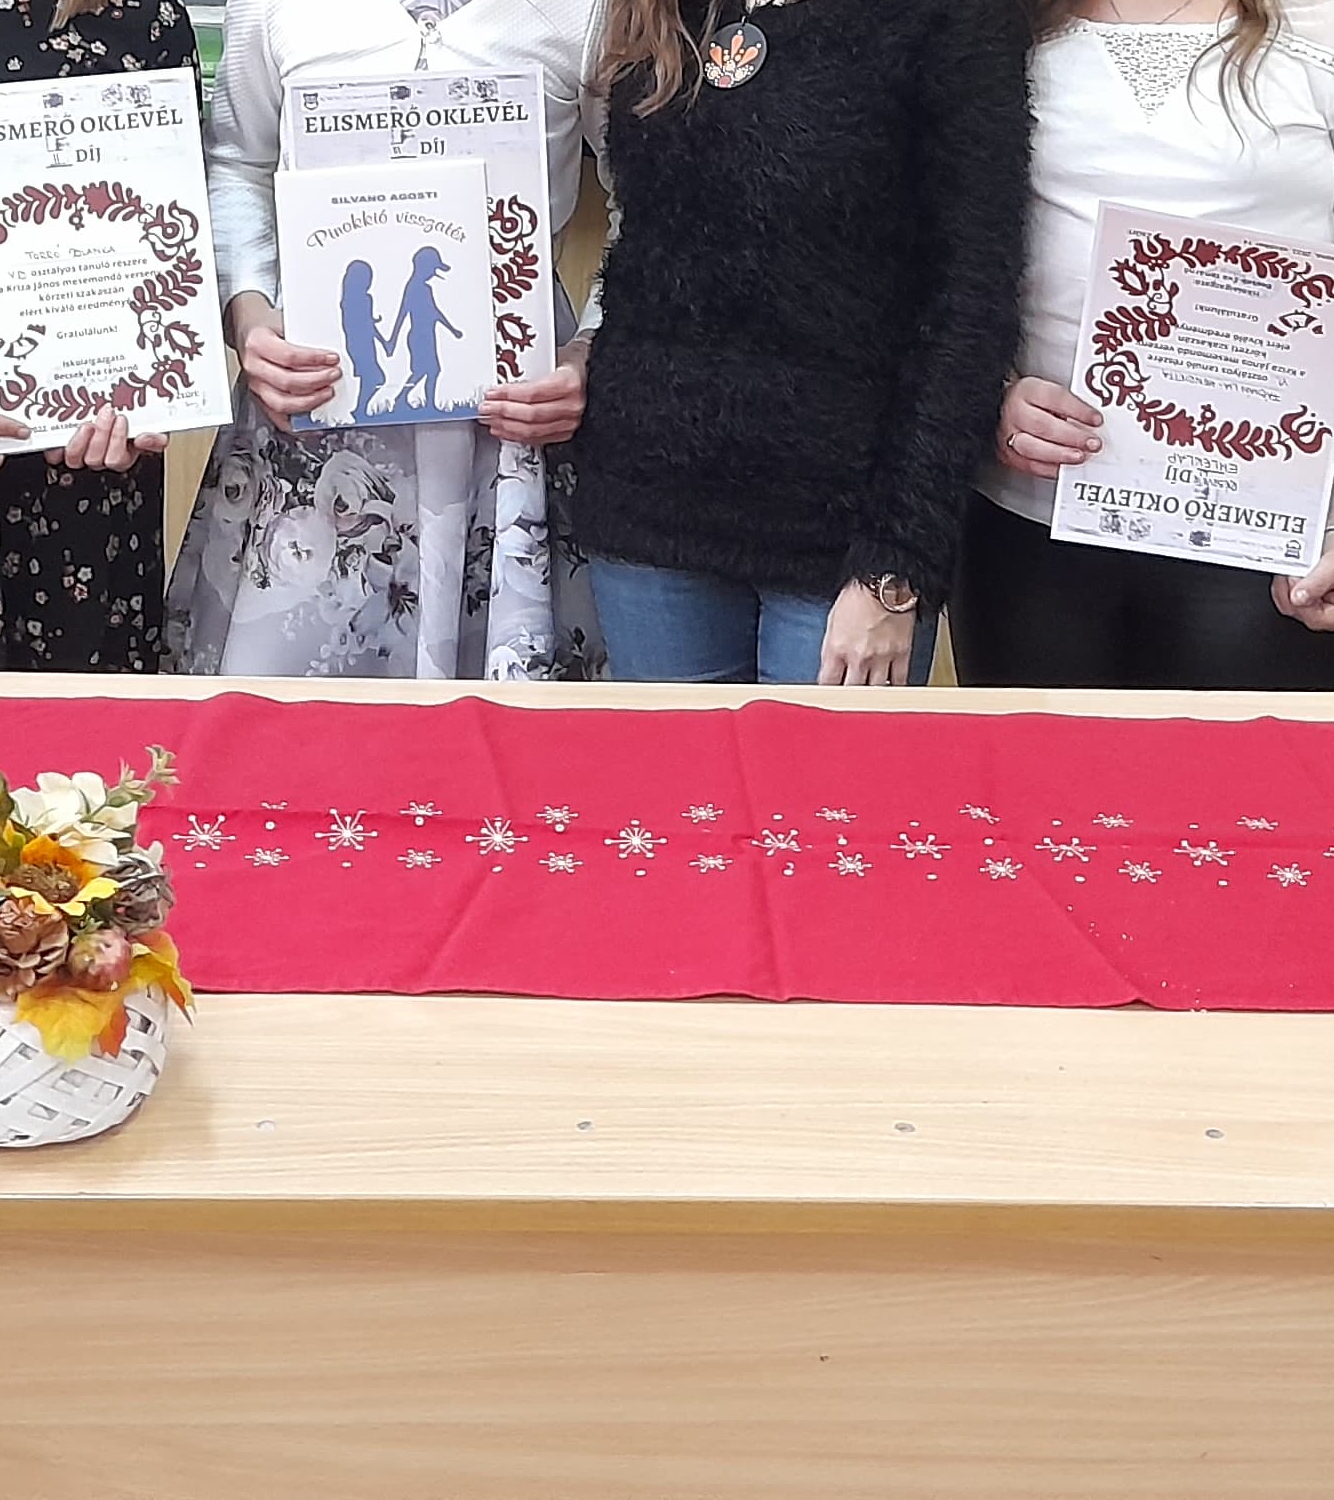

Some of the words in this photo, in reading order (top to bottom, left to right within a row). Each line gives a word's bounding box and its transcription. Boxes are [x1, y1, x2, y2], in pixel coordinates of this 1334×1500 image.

[79, 107, 182, 133] OKLEVÉL
[303, 103, 421, 133] ELISMERŐ
[425, 100, 528, 125] OKLEVÉL
[75, 144, 101, 163] DÍJ
[419, 137, 445, 156] DÍJ
[331, 194, 385, 204] SILVANO
[390, 191, 437, 200] AGOSTI
[306, 208, 387, 247] Pinokkió
[395, 211, 466, 242] visszatér
[1163, 464, 1192, 486] DÍJ
[1071, 481, 1180, 515] OKLEVÉL
[1183, 499, 1307, 534] ELISMERŐ
